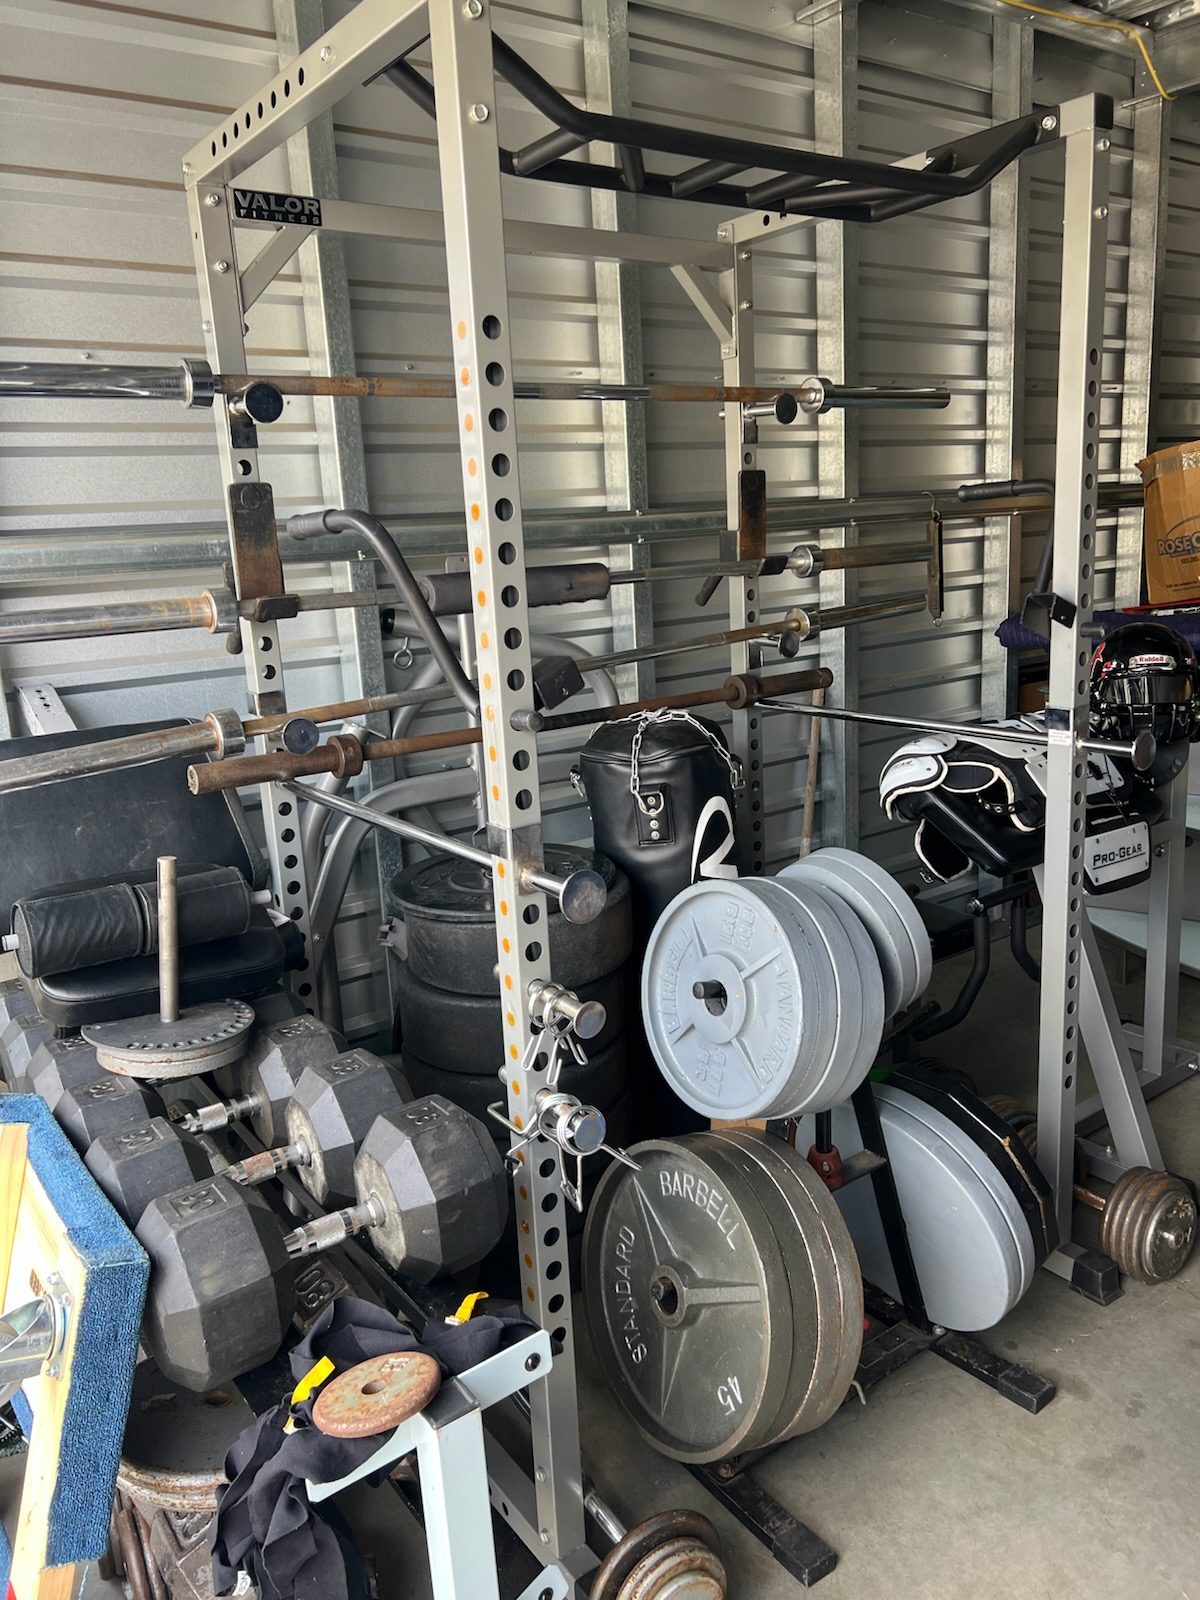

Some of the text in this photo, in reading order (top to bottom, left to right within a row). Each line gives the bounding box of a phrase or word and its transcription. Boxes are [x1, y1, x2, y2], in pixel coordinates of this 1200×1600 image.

[234, 190, 320, 216] VALOR
[240, 208, 320, 225] FITNESS
[1138, 655, 1165, 664] Riddell
[658, 1170, 740, 1252] BARBELL
[615, 1225, 648, 1364] STANDARD
[716, 1375, 743, 1417] 45
